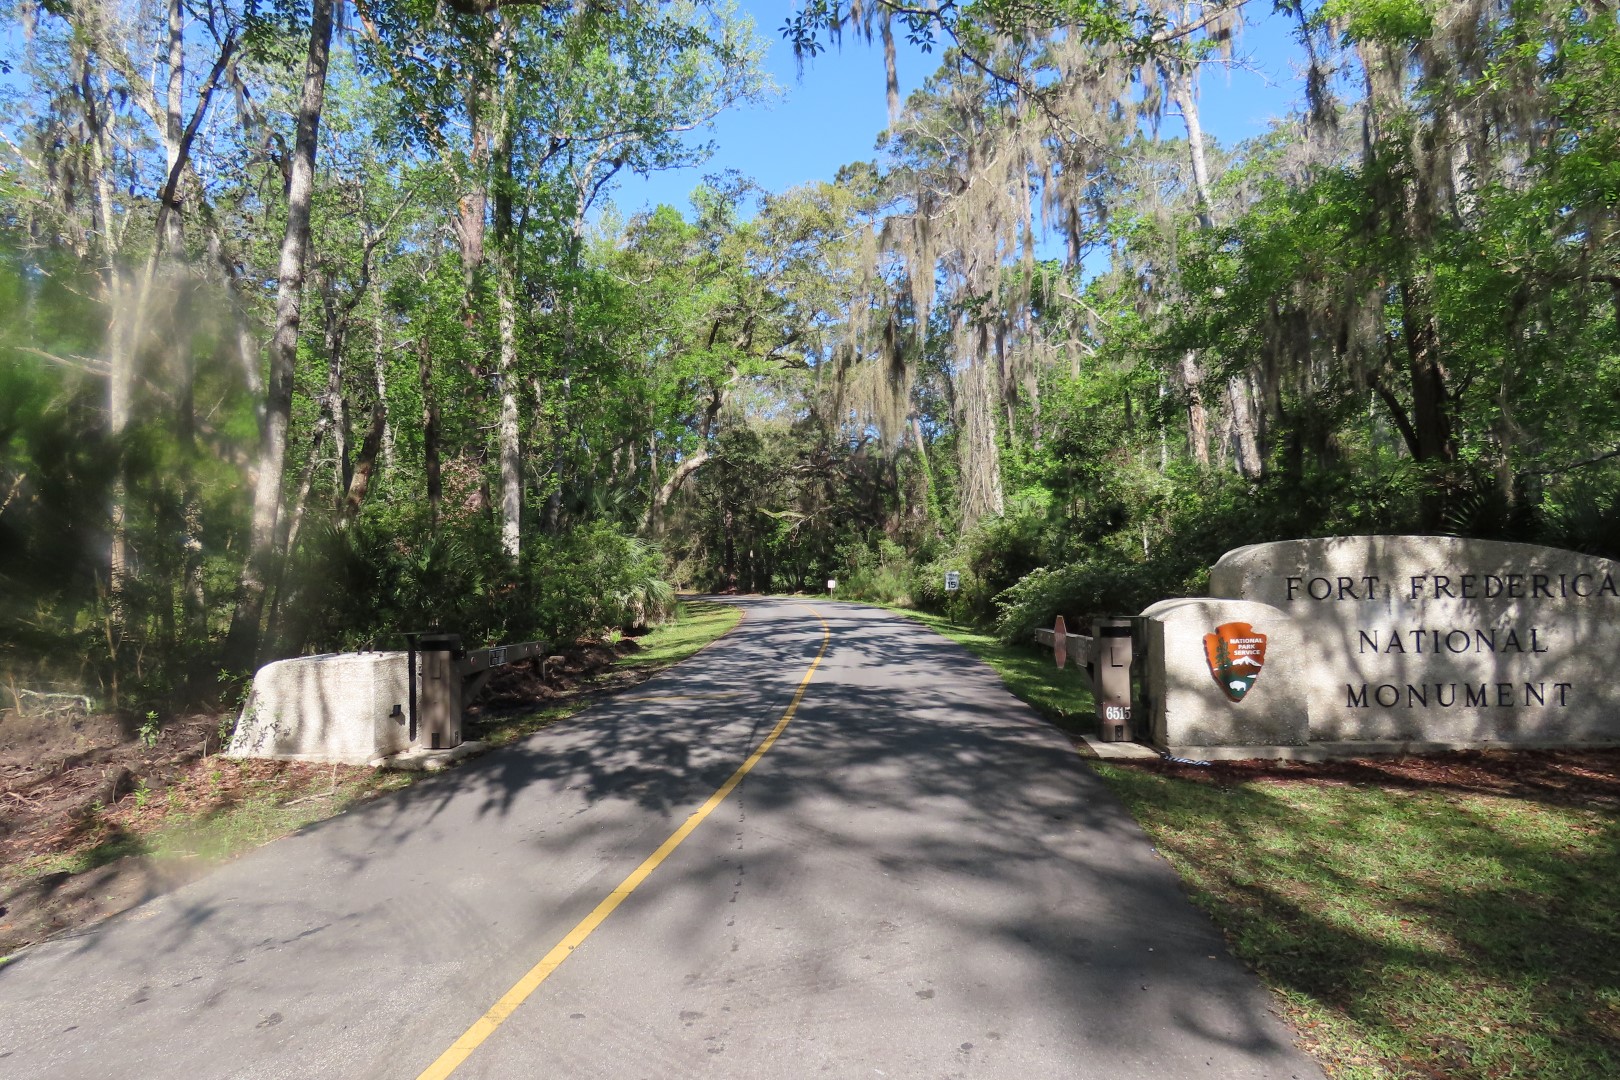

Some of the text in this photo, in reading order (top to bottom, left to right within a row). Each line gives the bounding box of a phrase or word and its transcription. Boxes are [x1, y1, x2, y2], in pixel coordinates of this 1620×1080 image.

[947, 581, 957, 589] 15
[1286, 573, 1619, 600] FORT FREDERICA
[1358, 628, 1548, 654] NATIONAL
[1346, 683, 1572, 708] MONUMENT
[1106, 706, 1131, 720] 6515
